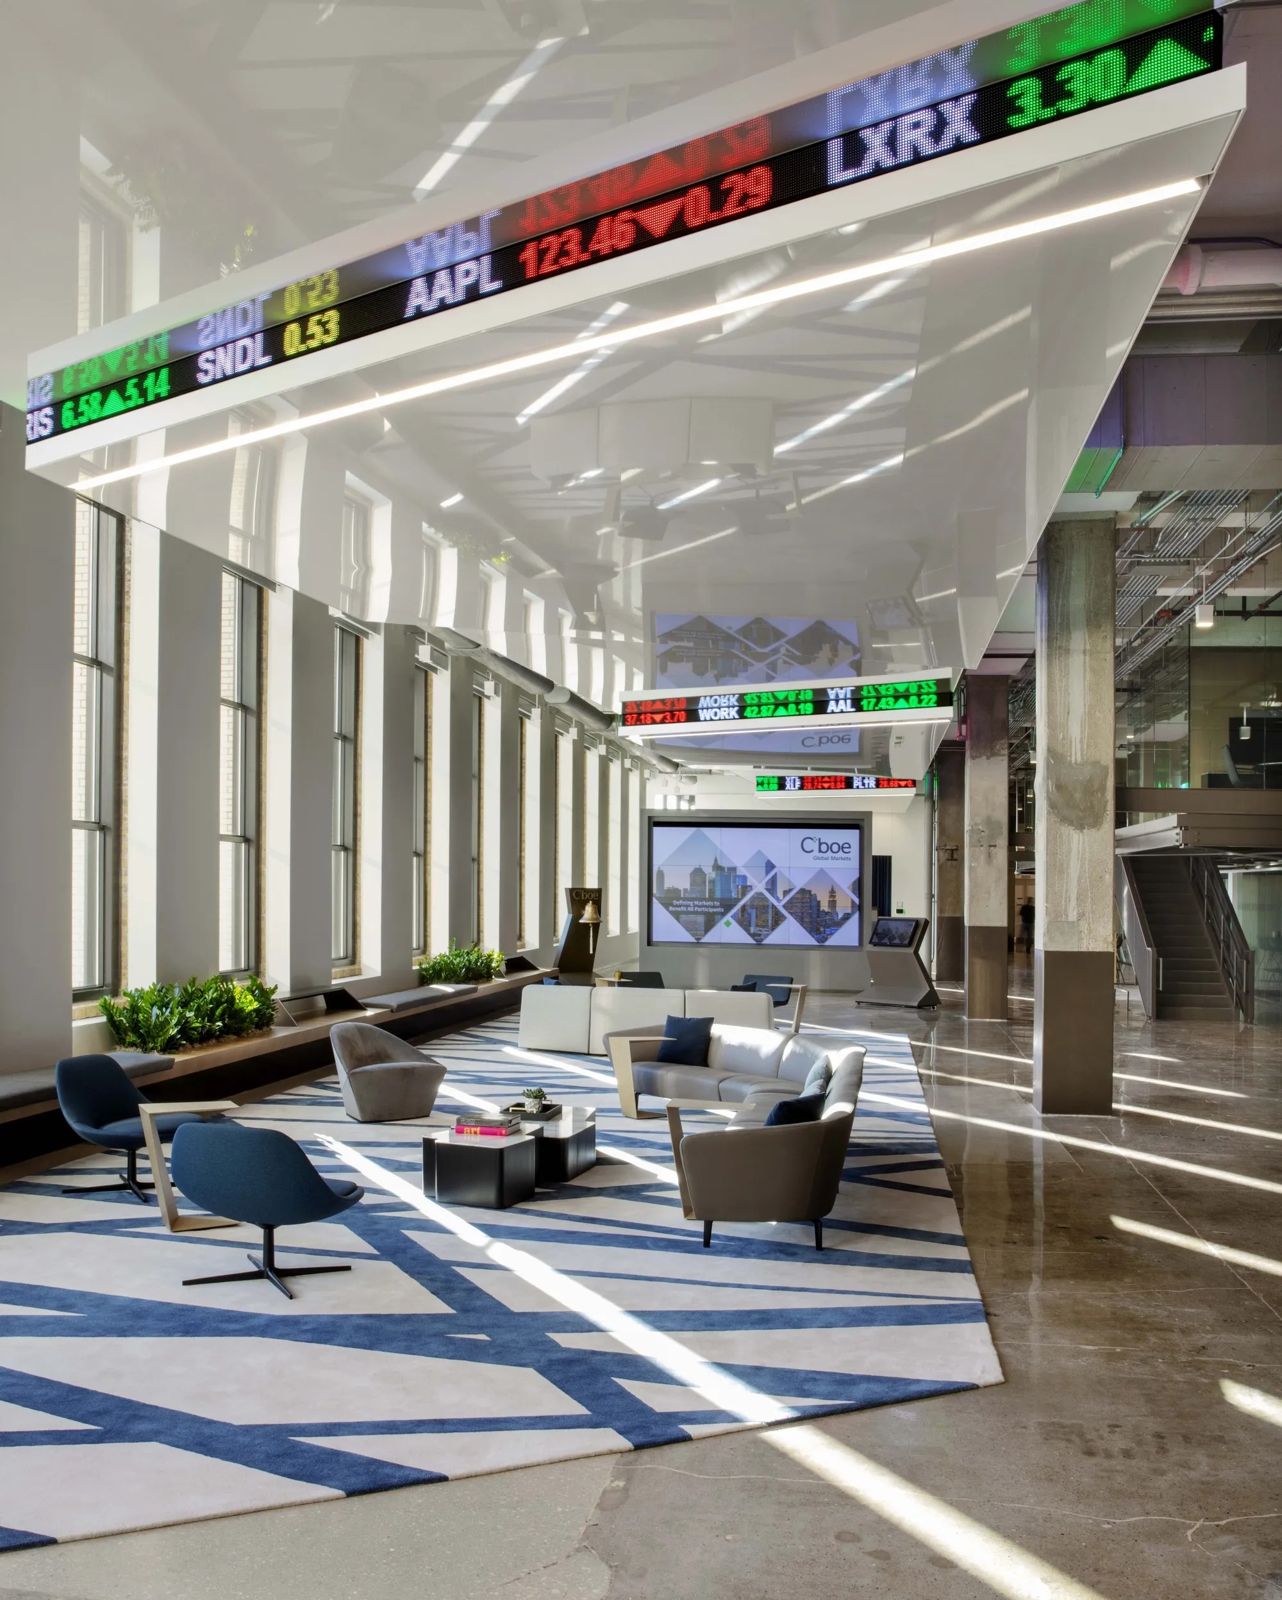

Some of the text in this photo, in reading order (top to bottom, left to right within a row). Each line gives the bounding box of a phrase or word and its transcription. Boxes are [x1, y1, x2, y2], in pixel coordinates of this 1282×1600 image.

[61, 391, 102, 430] 6.58
[125, 367, 171, 408] 5.14
[196, 332, 272, 385] SNDL
[283, 309, 340, 356] 0.53
[404, 254, 503, 319] AAPL
[518, 209, 637, 280] 123.46
[682, 165, 773, 228] 0.29
[825, 92, 981, 186] LXRX
[1005, 48, 1128, 129] 3.30
[698, 707, 740, 721] WORK
[826, 699, 857, 713] AAL
[860, 696, 895, 711] 17.43
[908, 694, 938, 707] 0.22
[673, 899, 693, 907] Defining
[694, 899, 713, 907] Markets
